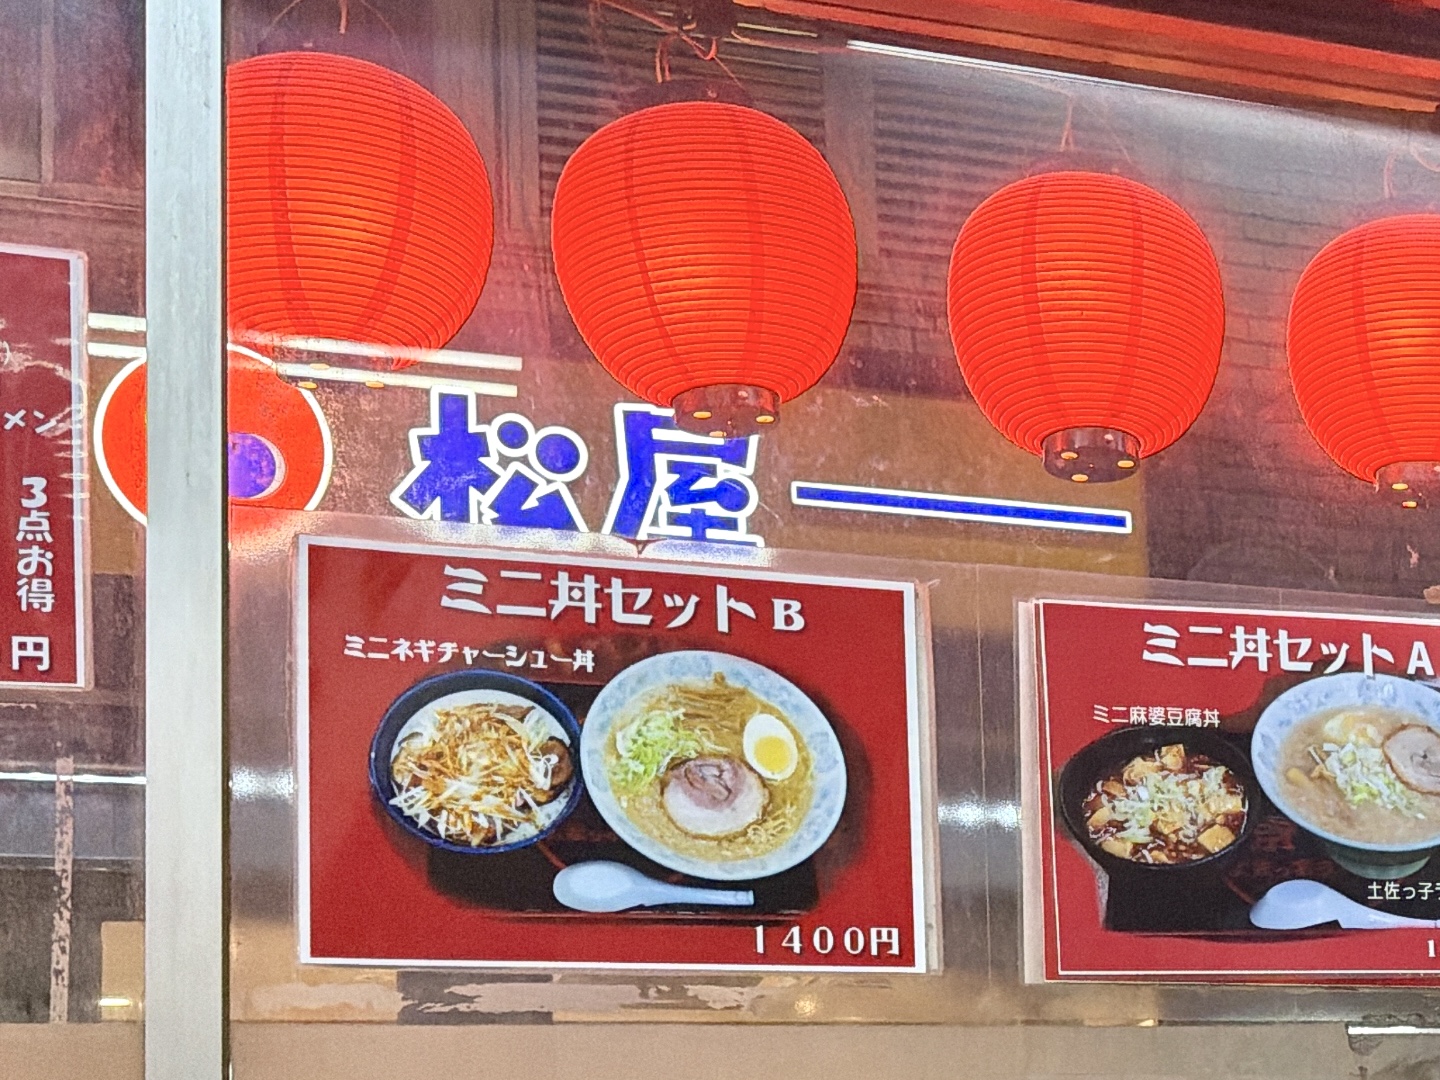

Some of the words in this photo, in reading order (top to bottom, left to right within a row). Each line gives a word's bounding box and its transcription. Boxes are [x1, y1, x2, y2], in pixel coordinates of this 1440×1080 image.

[391, 385, 764, 548] 松屋
[16, 476, 55, 613] 3点お得
[440, 563, 756, 634] ミニ丼セット
[772, 599, 806, 631] B
[343, 634, 595, 673] ミニネギチャーシュー丼
[1143, 621, 1395, 677] ミニ丼セット
[1407, 640, 1434, 675] A
[1093, 704, 1220, 728] ミニ麻婆豆腐丼
[753, 924, 901, 957] 1400円
